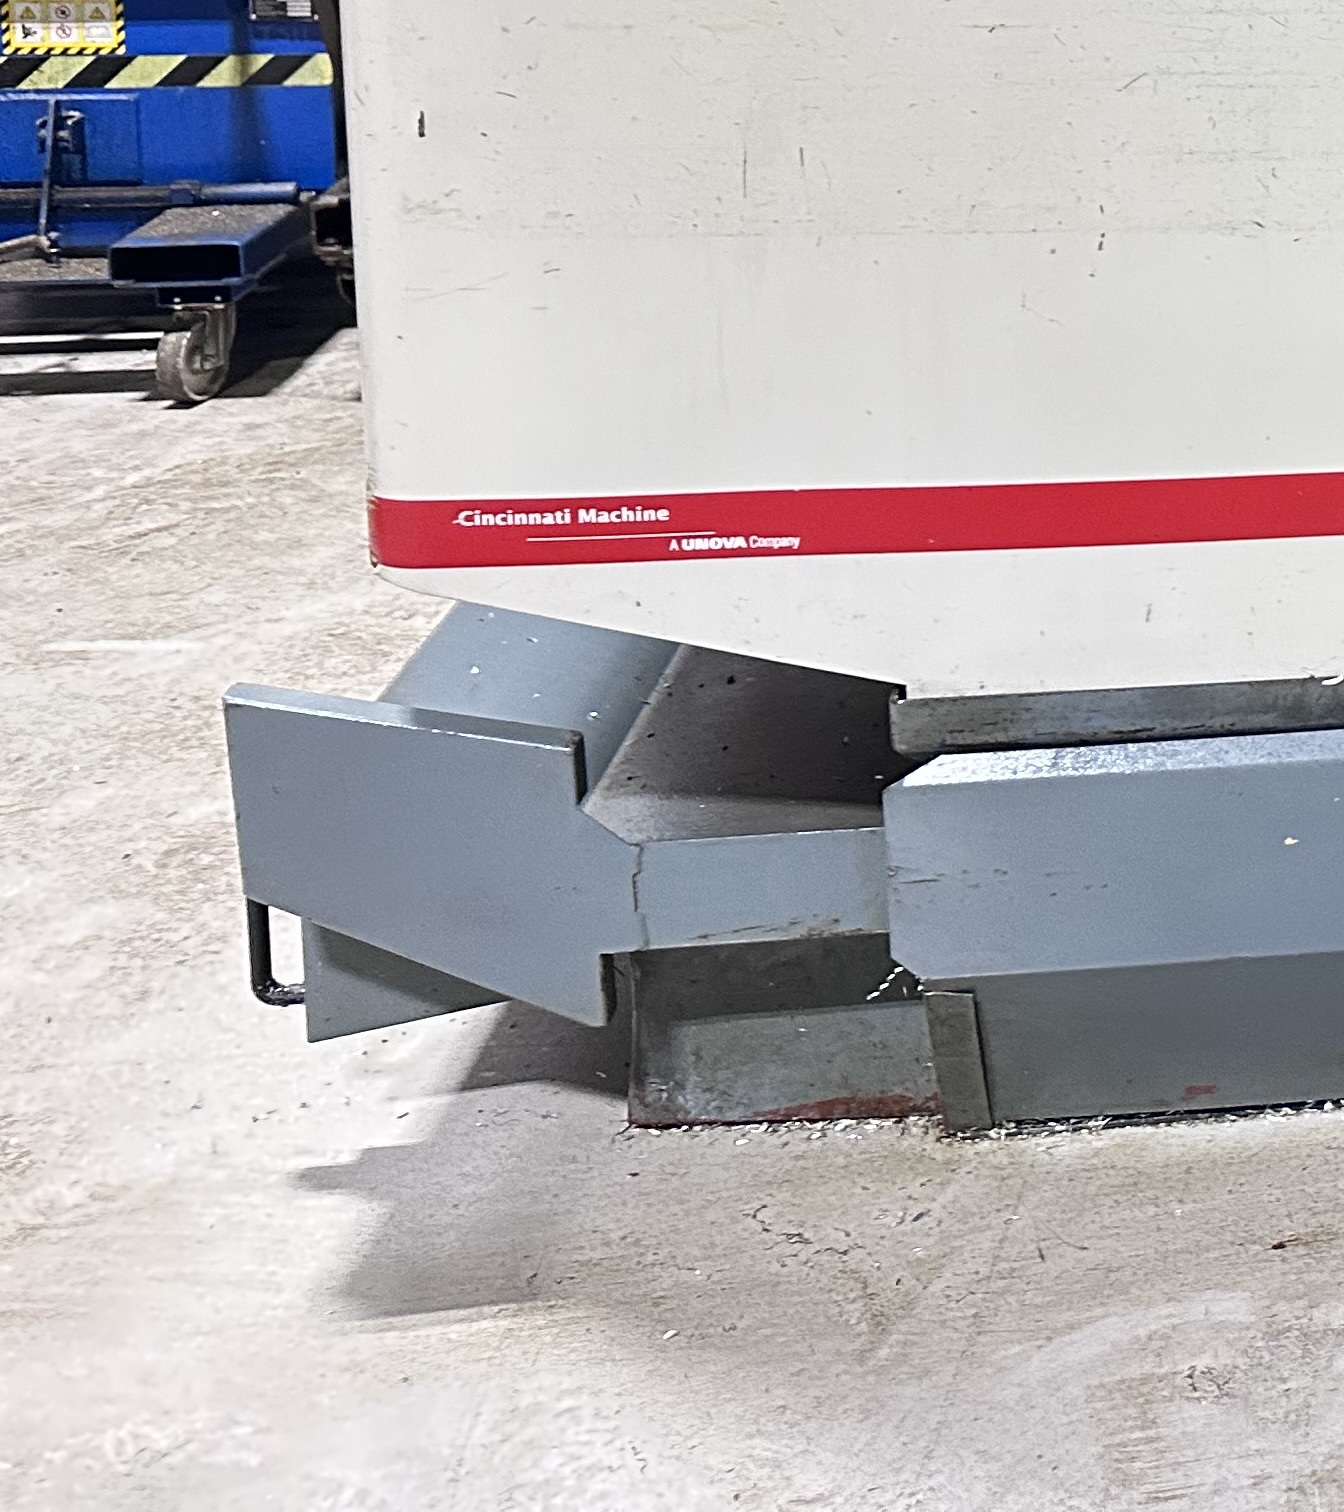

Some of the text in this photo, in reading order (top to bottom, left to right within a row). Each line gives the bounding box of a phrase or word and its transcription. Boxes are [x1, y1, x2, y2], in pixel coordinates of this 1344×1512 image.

[453, 506, 670, 527] Cincinnati Machine
[668, 539, 680, 552] A
[681, 536, 748, 552] UNOVA
